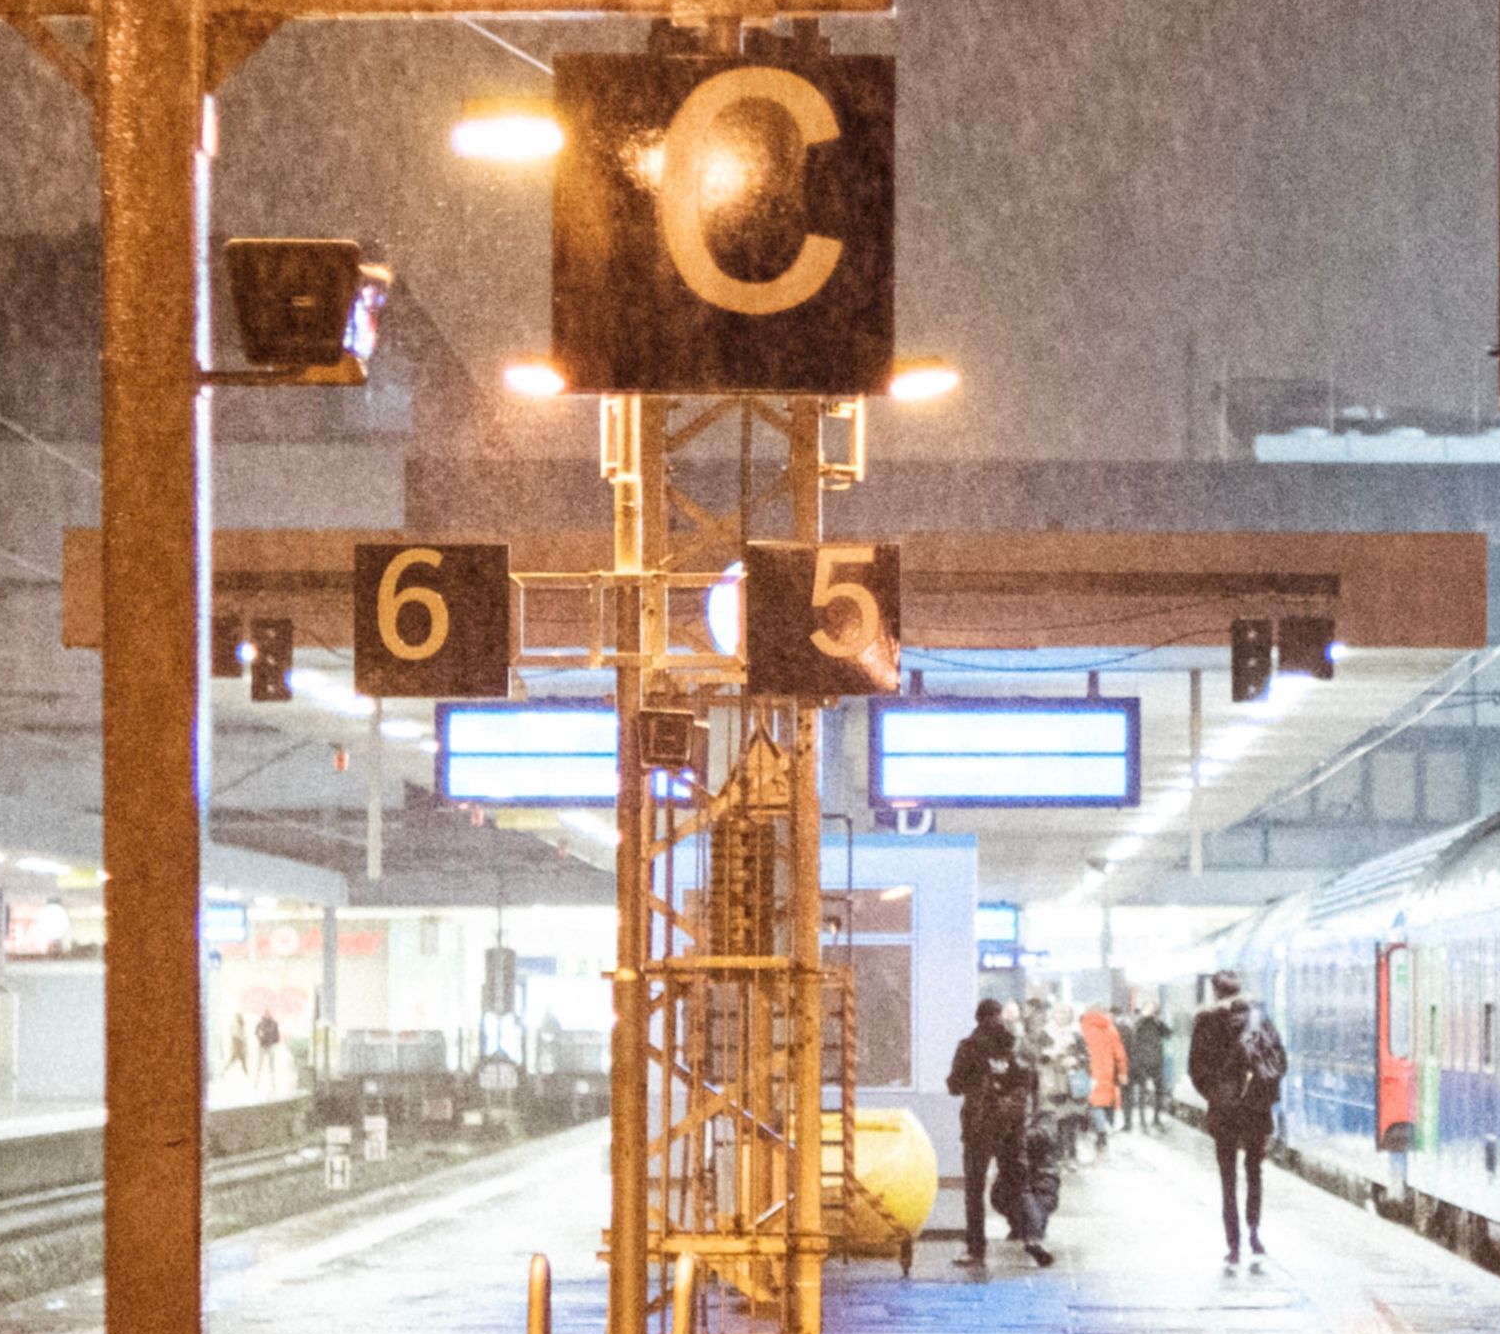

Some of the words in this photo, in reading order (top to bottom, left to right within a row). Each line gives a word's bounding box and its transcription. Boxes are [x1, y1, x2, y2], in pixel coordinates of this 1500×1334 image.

[660, 65, 843, 316] C
[376, 547, 451, 662] 6
[808, 545, 879, 659] 5
[329, 1159, 347, 1186] H
